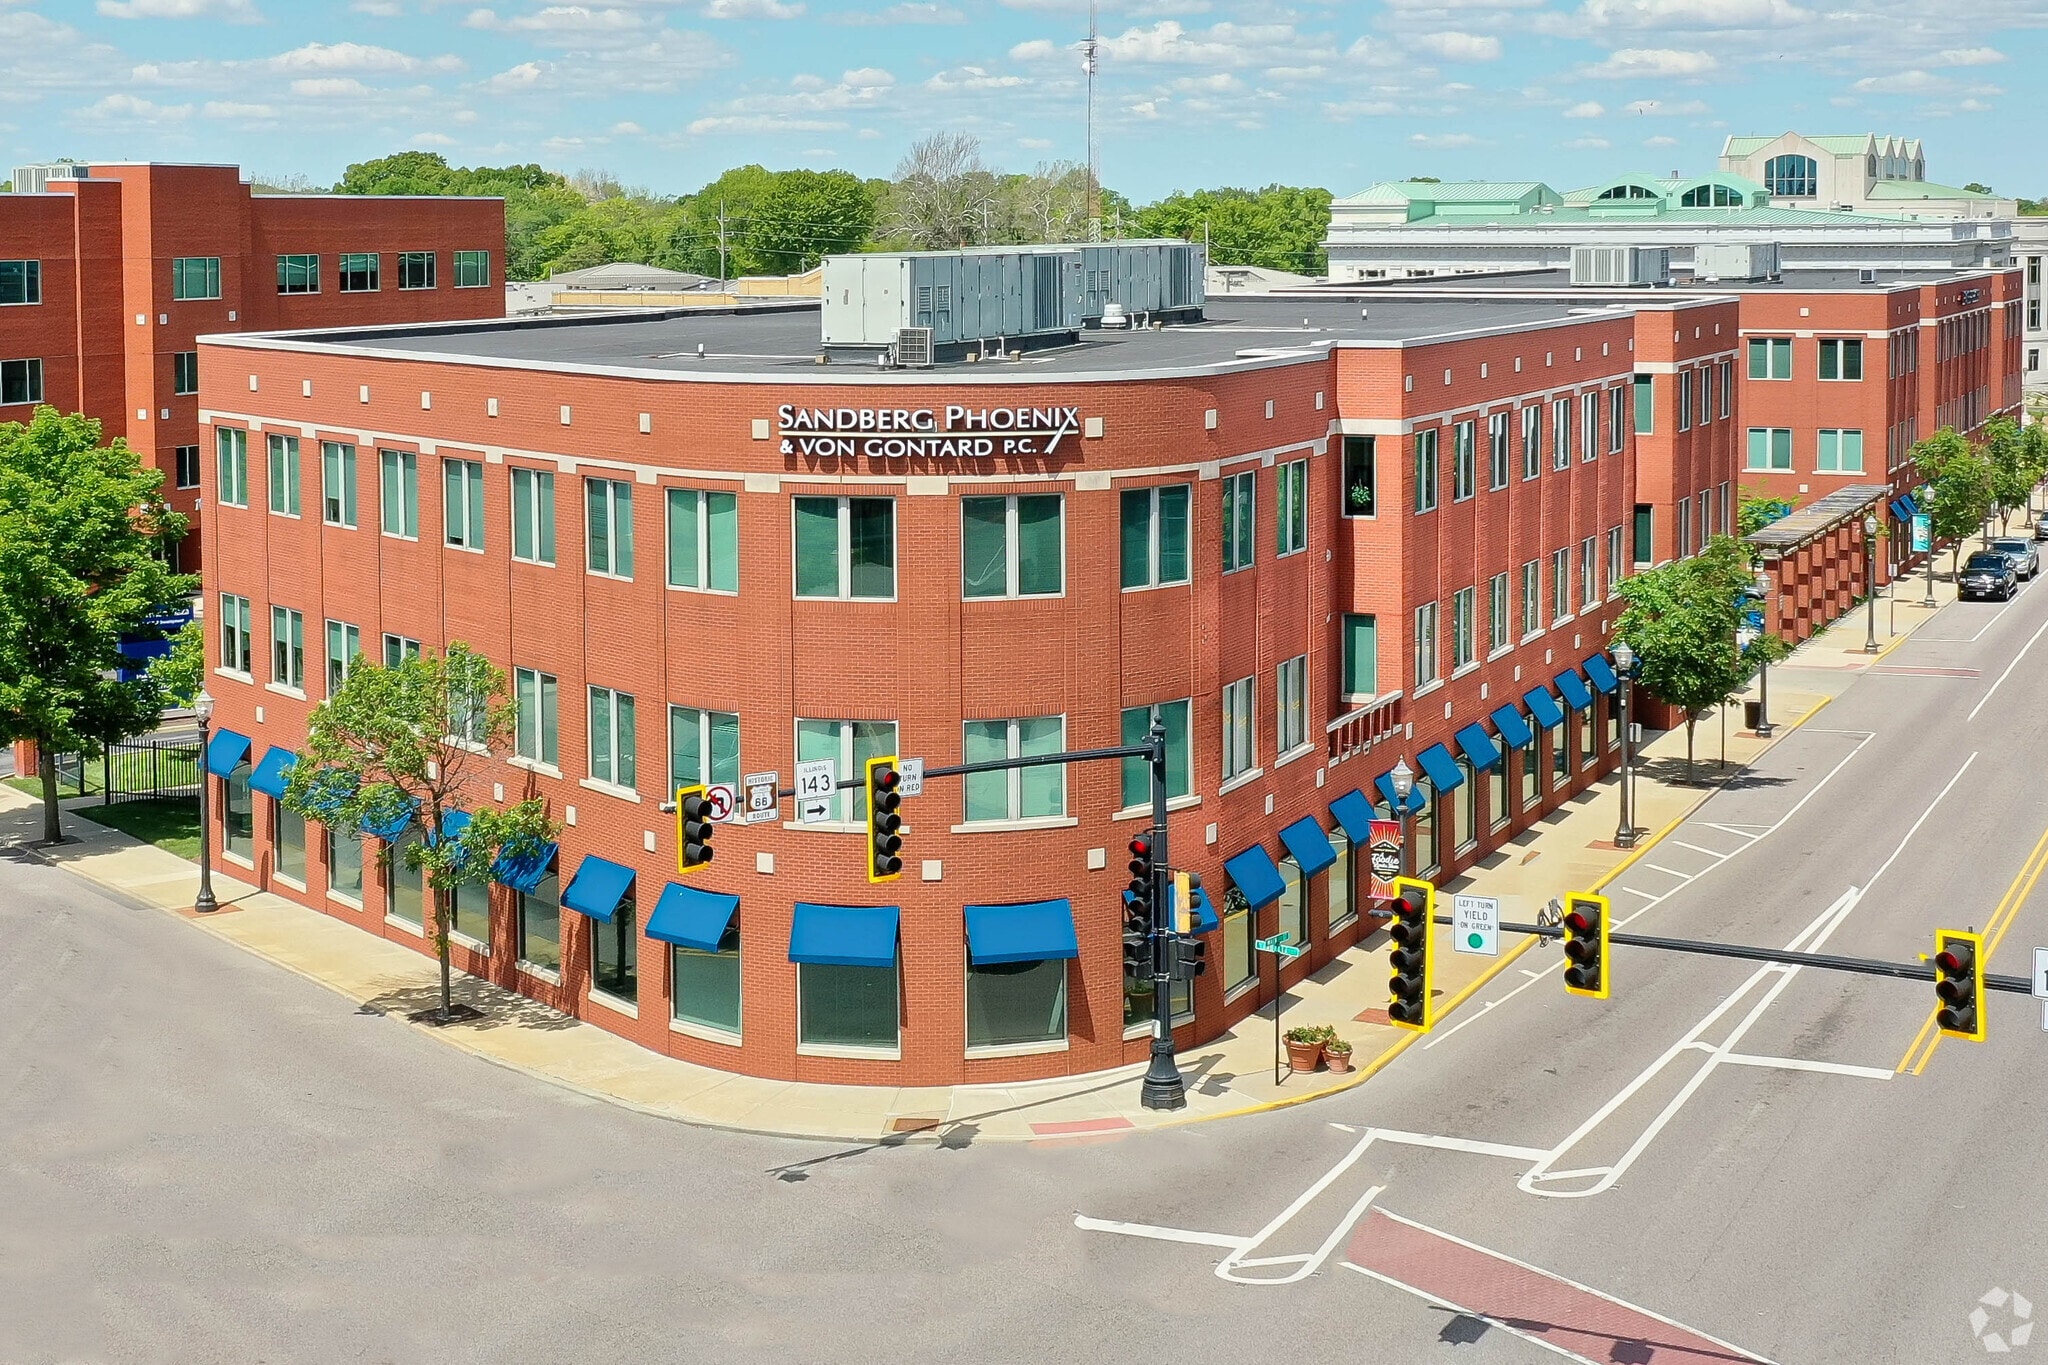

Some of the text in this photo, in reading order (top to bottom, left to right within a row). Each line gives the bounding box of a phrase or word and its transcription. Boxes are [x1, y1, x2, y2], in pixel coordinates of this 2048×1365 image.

[779, 438, 1037, 457] & VON GONTARD P.C.
[803, 765, 827, 773] ILLINOIS
[903, 764, 913, 772] NO
[748, 775, 774, 784] HISTORIC
[802, 774, 831, 794] 143
[906, 783, 920, 791] RED
[755, 797, 768, 807] 66
[752, 811, 770, 819] ROUTE
[1458, 900, 1494, 909] LEFT TURN
[1464, 910, 1488, 920] YIELD
[1460, 921, 1492, 931] ON GREEN
